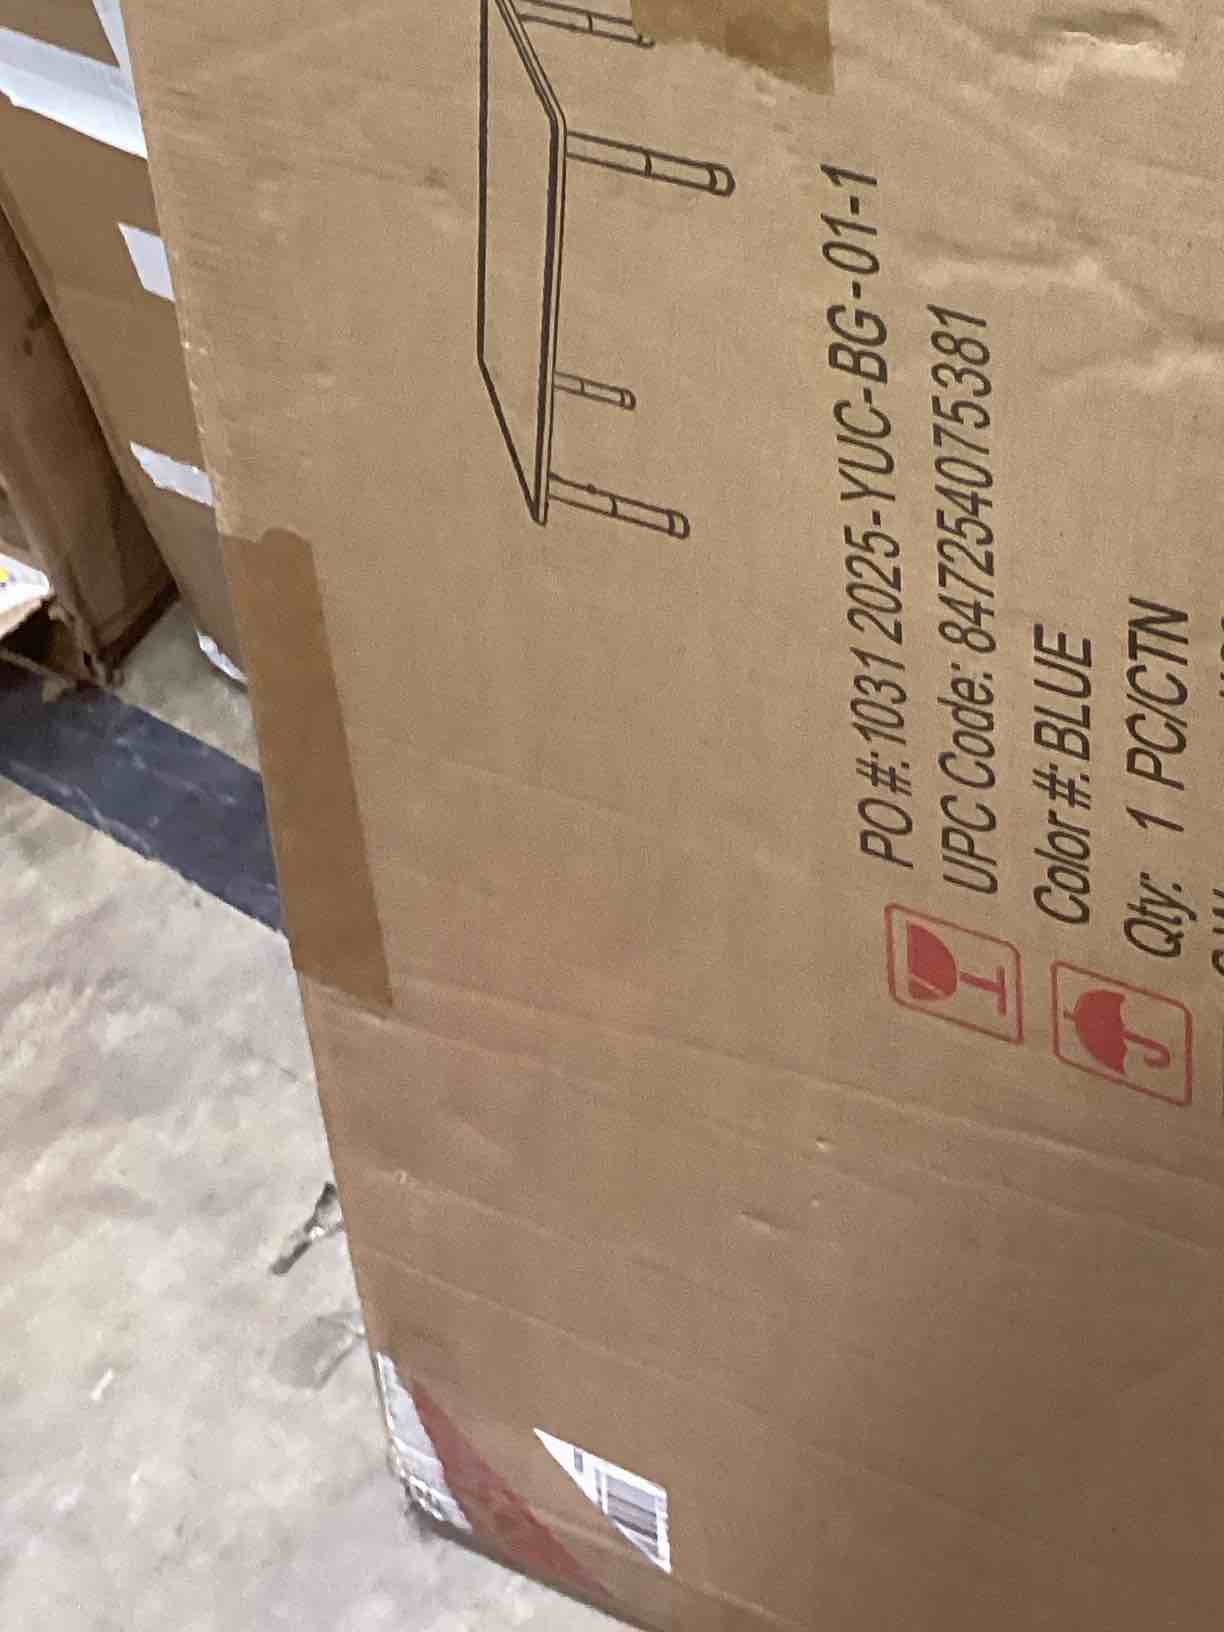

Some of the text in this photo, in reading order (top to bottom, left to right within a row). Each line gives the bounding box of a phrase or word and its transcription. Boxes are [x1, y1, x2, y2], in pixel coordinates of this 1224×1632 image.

[927, 304, 998, 894] UPC Code: 847254075381
[1123, 596, 1197, 959] Qty: 1 PC/CTN
